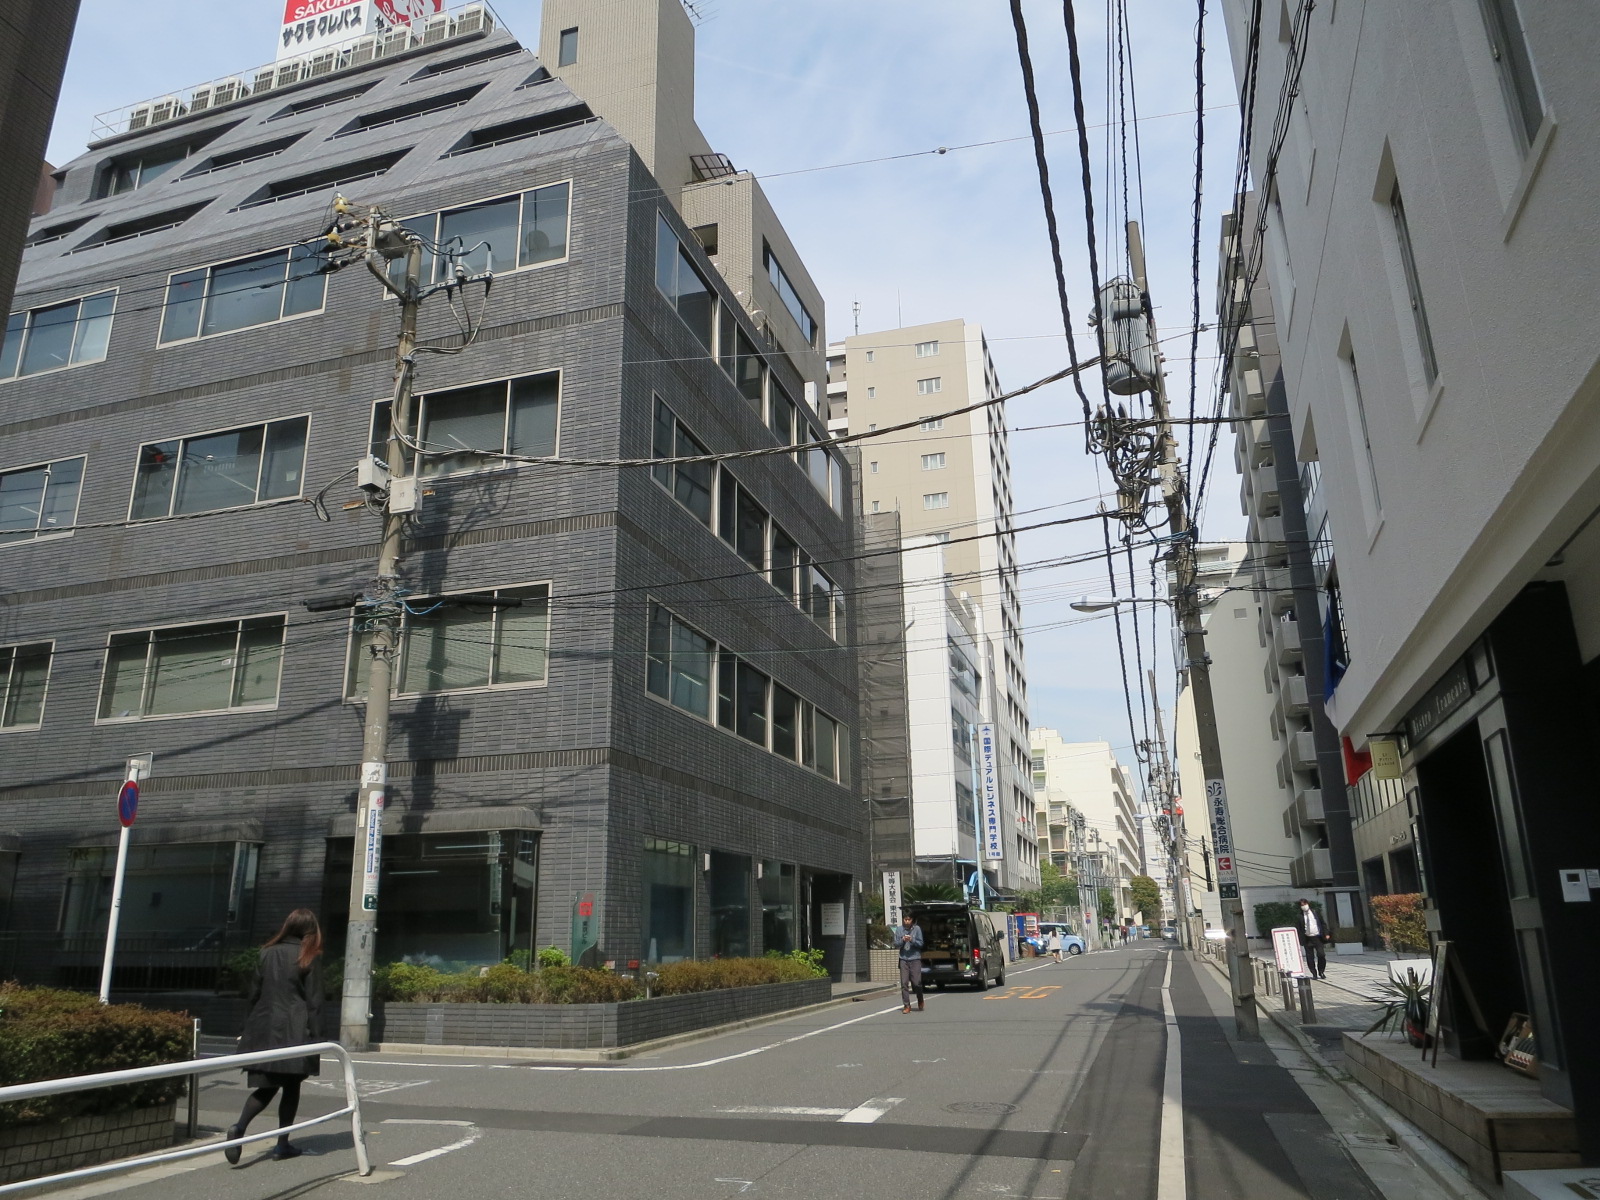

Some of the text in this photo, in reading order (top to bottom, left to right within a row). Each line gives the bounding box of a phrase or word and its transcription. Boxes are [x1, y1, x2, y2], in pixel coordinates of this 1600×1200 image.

[294, 0, 352, 19] SAKU
[1213, 797, 1230, 854] 永寿総合病院
[982, 985, 1064, 1000] 30
